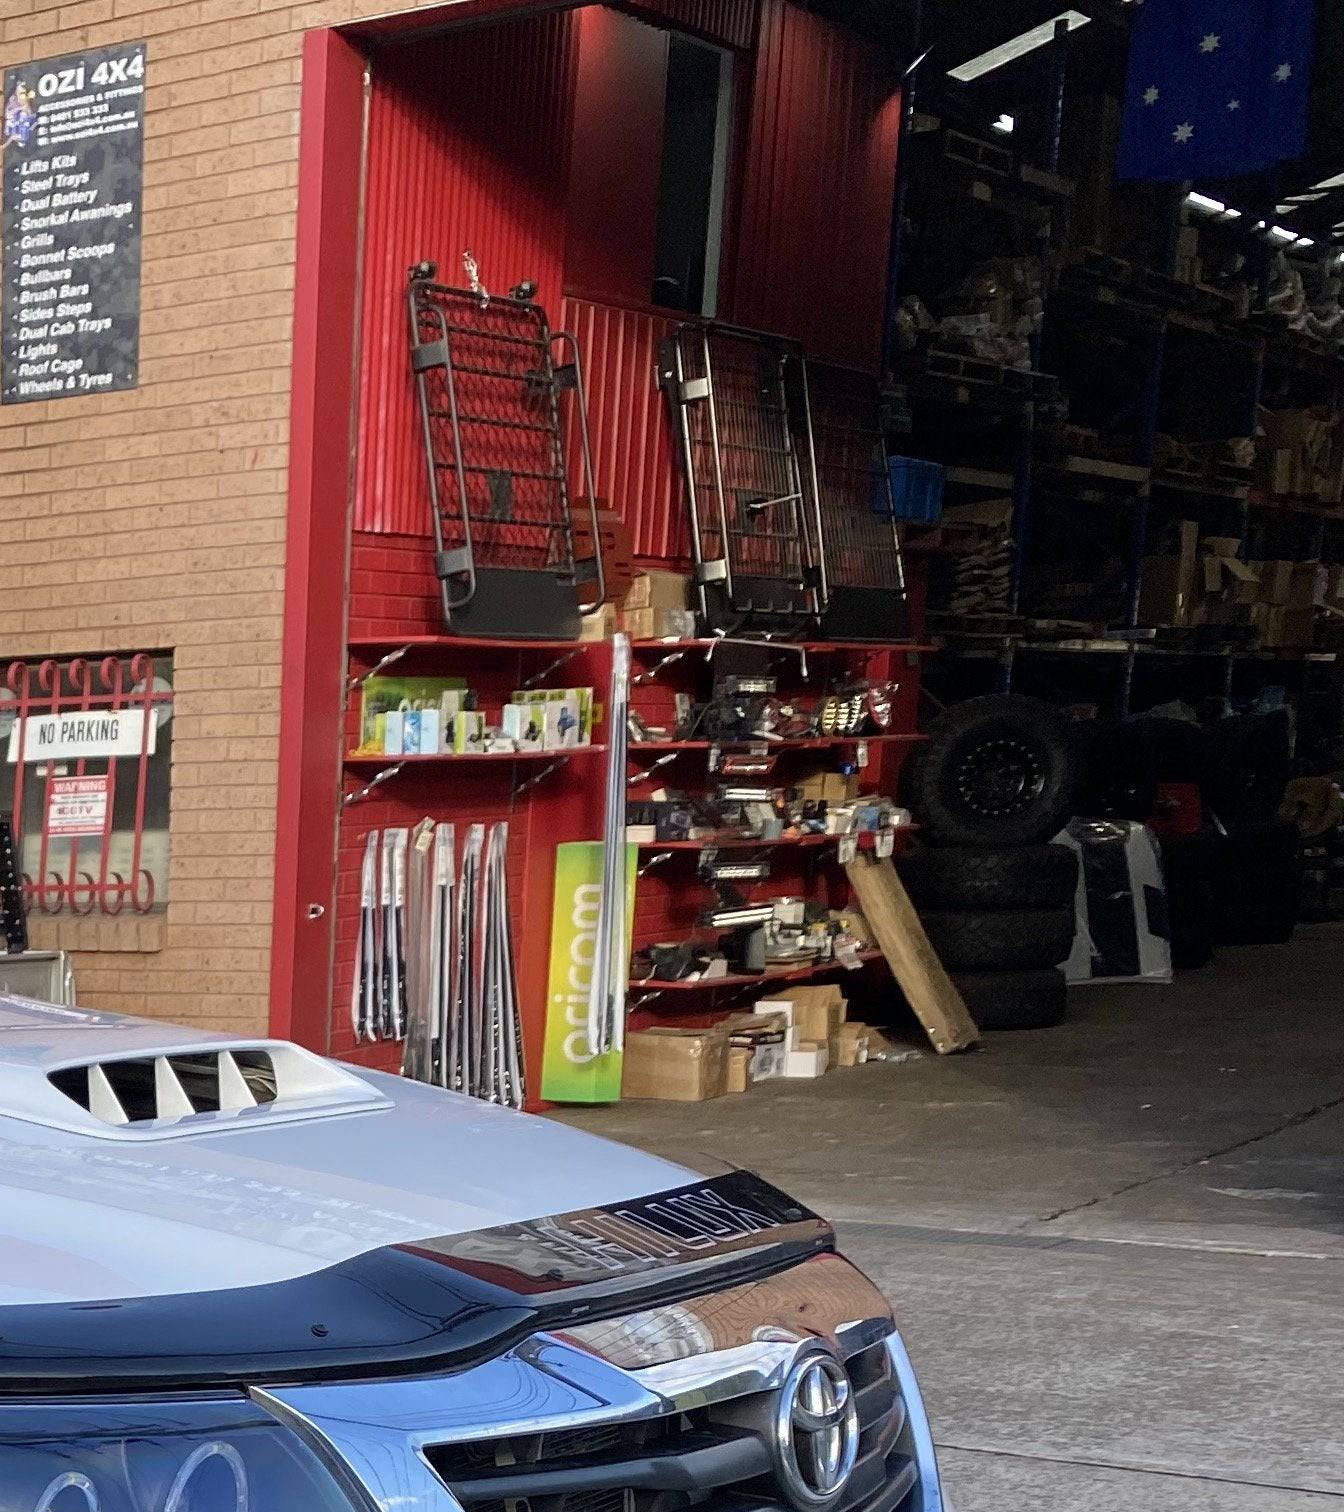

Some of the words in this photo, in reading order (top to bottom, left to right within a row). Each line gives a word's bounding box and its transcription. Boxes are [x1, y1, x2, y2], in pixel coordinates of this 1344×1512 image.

[37, 67, 85, 97] OZI
[90, 54, 144, 85] 4X4
[51, 154, 77, 169] Kits
[20, 176, 53, 194] Steel
[55, 172, 90, 188] Trays
[20, 195, 50, 213] Dual
[51, 189, 98, 207] Battery
[20, 232, 54, 249] Grills
[19, 248, 66, 268] Bonnet
[66, 242, 115, 260] Scoops
[20, 268, 72, 286] Bullbars
[19, 286, 57, 304] Brush
[59, 283, 89, 298] Bars
[19, 307, 54, 322] Sides
[56, 302, 92, 317] Steps
[18, 324, 48, 341] Dual
[50, 321, 75, 337] Cab
[77, 317, 112, 333] Trays
[18, 343, 58, 360] Lights
[18, 359, 50, 376] Roof
[18, 378, 64, 394] Wheels
[78, 372, 113, 389] Tyres
[38, 722, 55, 745] NO
[61, 719, 119, 742] PARKING
